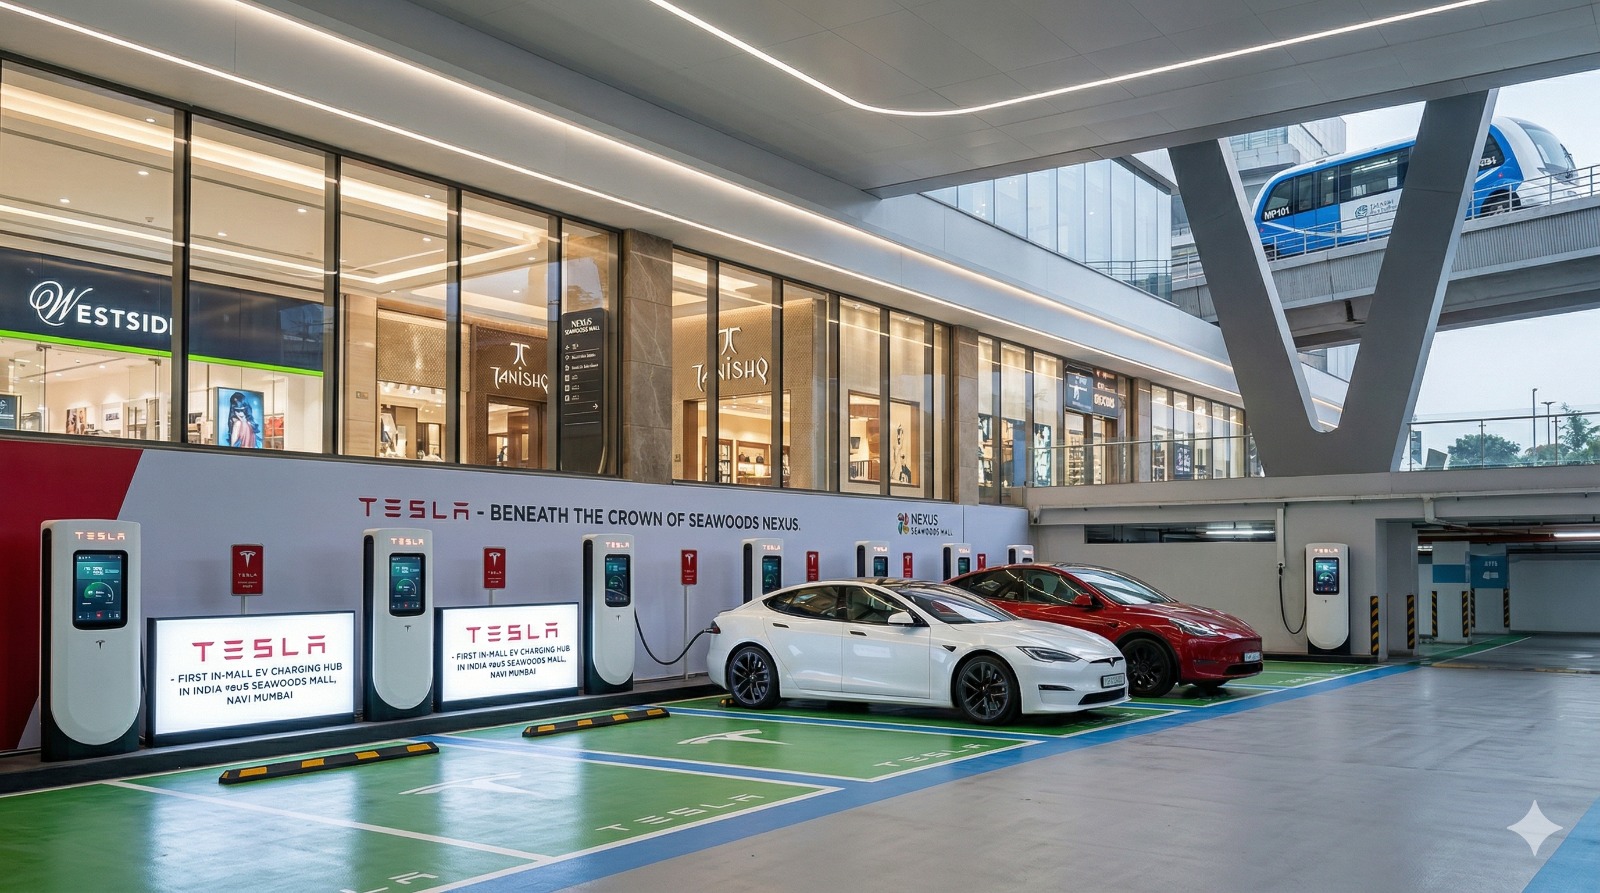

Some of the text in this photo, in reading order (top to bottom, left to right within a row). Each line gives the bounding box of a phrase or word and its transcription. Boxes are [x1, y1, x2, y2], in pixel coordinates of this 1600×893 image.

[1264, 206, 1289, 220] MP101
[29, 280, 173, 336] WESTSID
[358, 497, 469, 520] TESLA
[490, 503, 569, 524] BENEATH
[573, 507, 604, 525] THE
[607, 509, 663, 527] CROWN
[666, 512, 685, 527] OF
[688, 512, 760, 530] SEAWOODS
[762, 516, 801, 531] NEXUS.
[911, 513, 939, 526] NEXUS
[75, 531, 126, 541] TESLA
[390, 537, 424, 546] TESLA
[466, 622, 558, 643] TESLA
[191, 635, 326, 662] TESLA
[456, 651, 477, 660] FIRST
[478, 650, 508, 659] IN-MALL
[509, 648, 519, 657] EV
[519, 646, 556, 656] CHARGING
[556, 644, 571, 653] HUB
[178, 672, 208, 683] FIRST
[211, 669, 253, 681] IN-MALL
[255, 668, 269, 677] EV
[270, 664, 321, 676] CHARGING
[323, 662, 343, 672] HUB
[457, 663, 466, 671] IN
[466, 661, 488, 671] INDIA
[506, 656, 546, 667] SEAWOODS
[490, 668, 536, 679] NAVI MUMBAI
[179, 686, 190, 697] IN
[193, 684, 223, 696] INDIA
[251, 677, 307, 690] SEAWOODS
[309, 675, 337, 685] MALL,
[226, 690, 293, 705] NAVI MUMBAI
[873, 743, 991, 767] TESLA
[595, 793, 765, 831] TESLA
